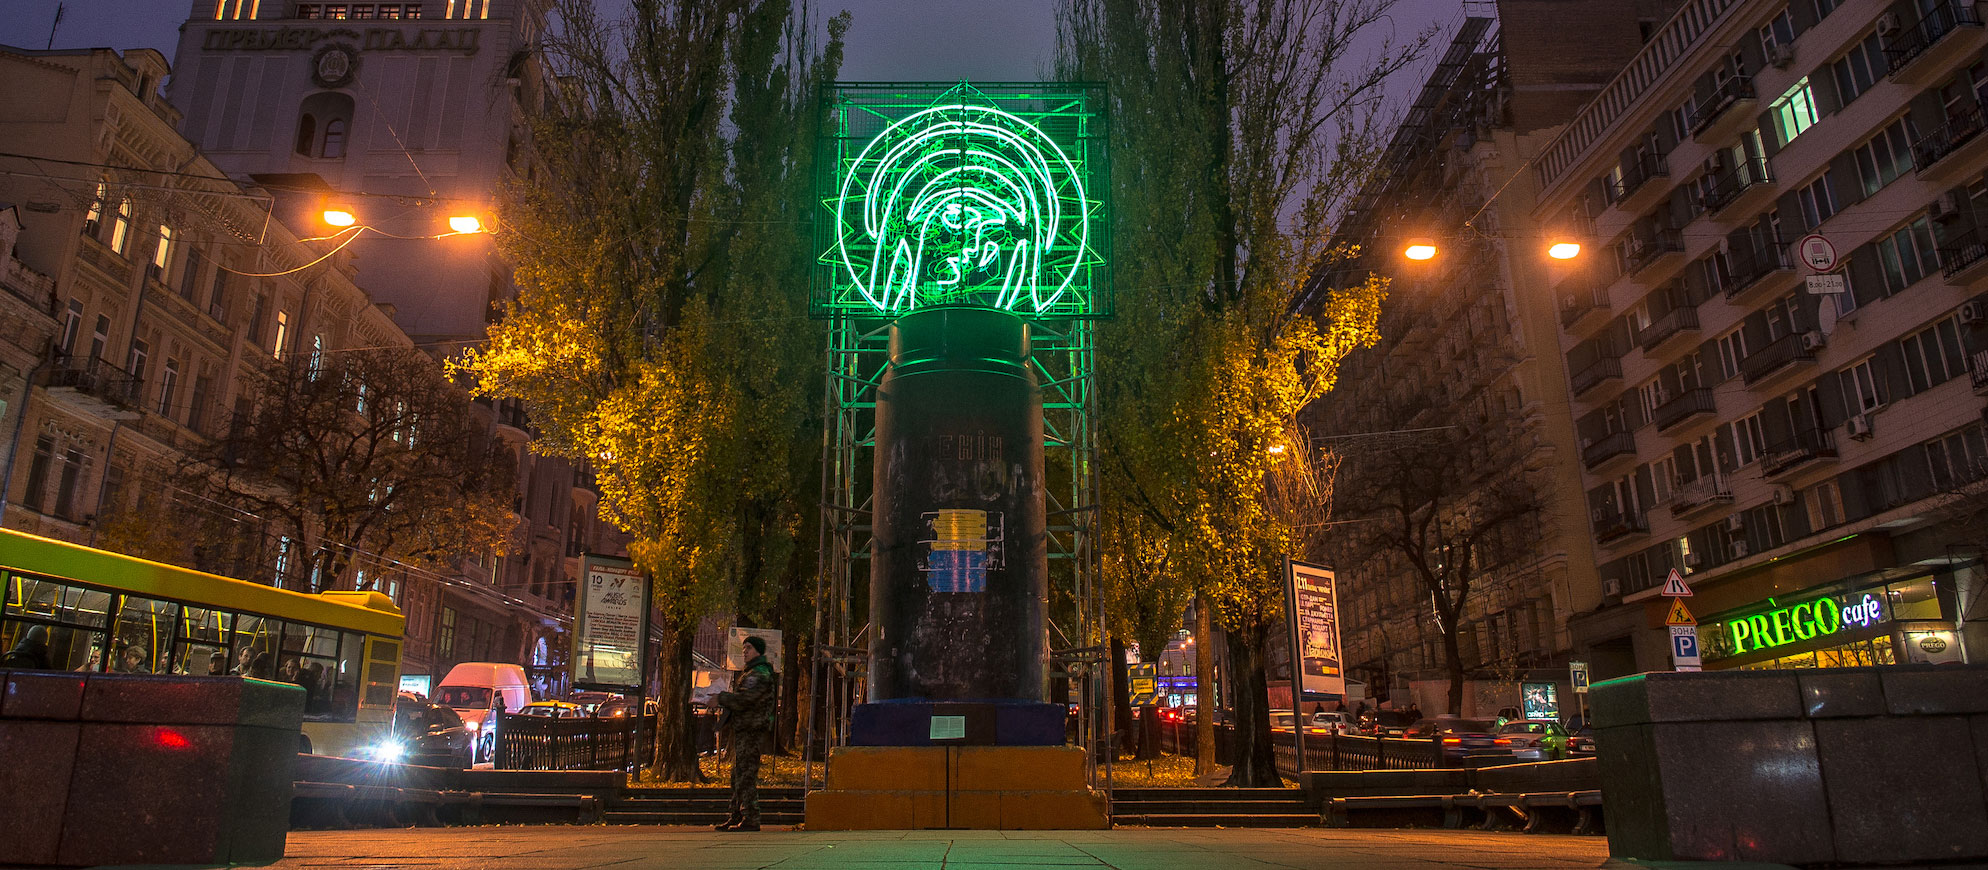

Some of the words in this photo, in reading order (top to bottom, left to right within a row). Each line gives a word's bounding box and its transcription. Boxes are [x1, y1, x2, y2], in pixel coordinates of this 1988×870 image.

[363, 27, 481, 56] ПАЛАЦ
[592, 574, 603, 585] 10
[1671, 627, 1696, 635] ЗОНА
[1679, 637, 1692, 656] P
